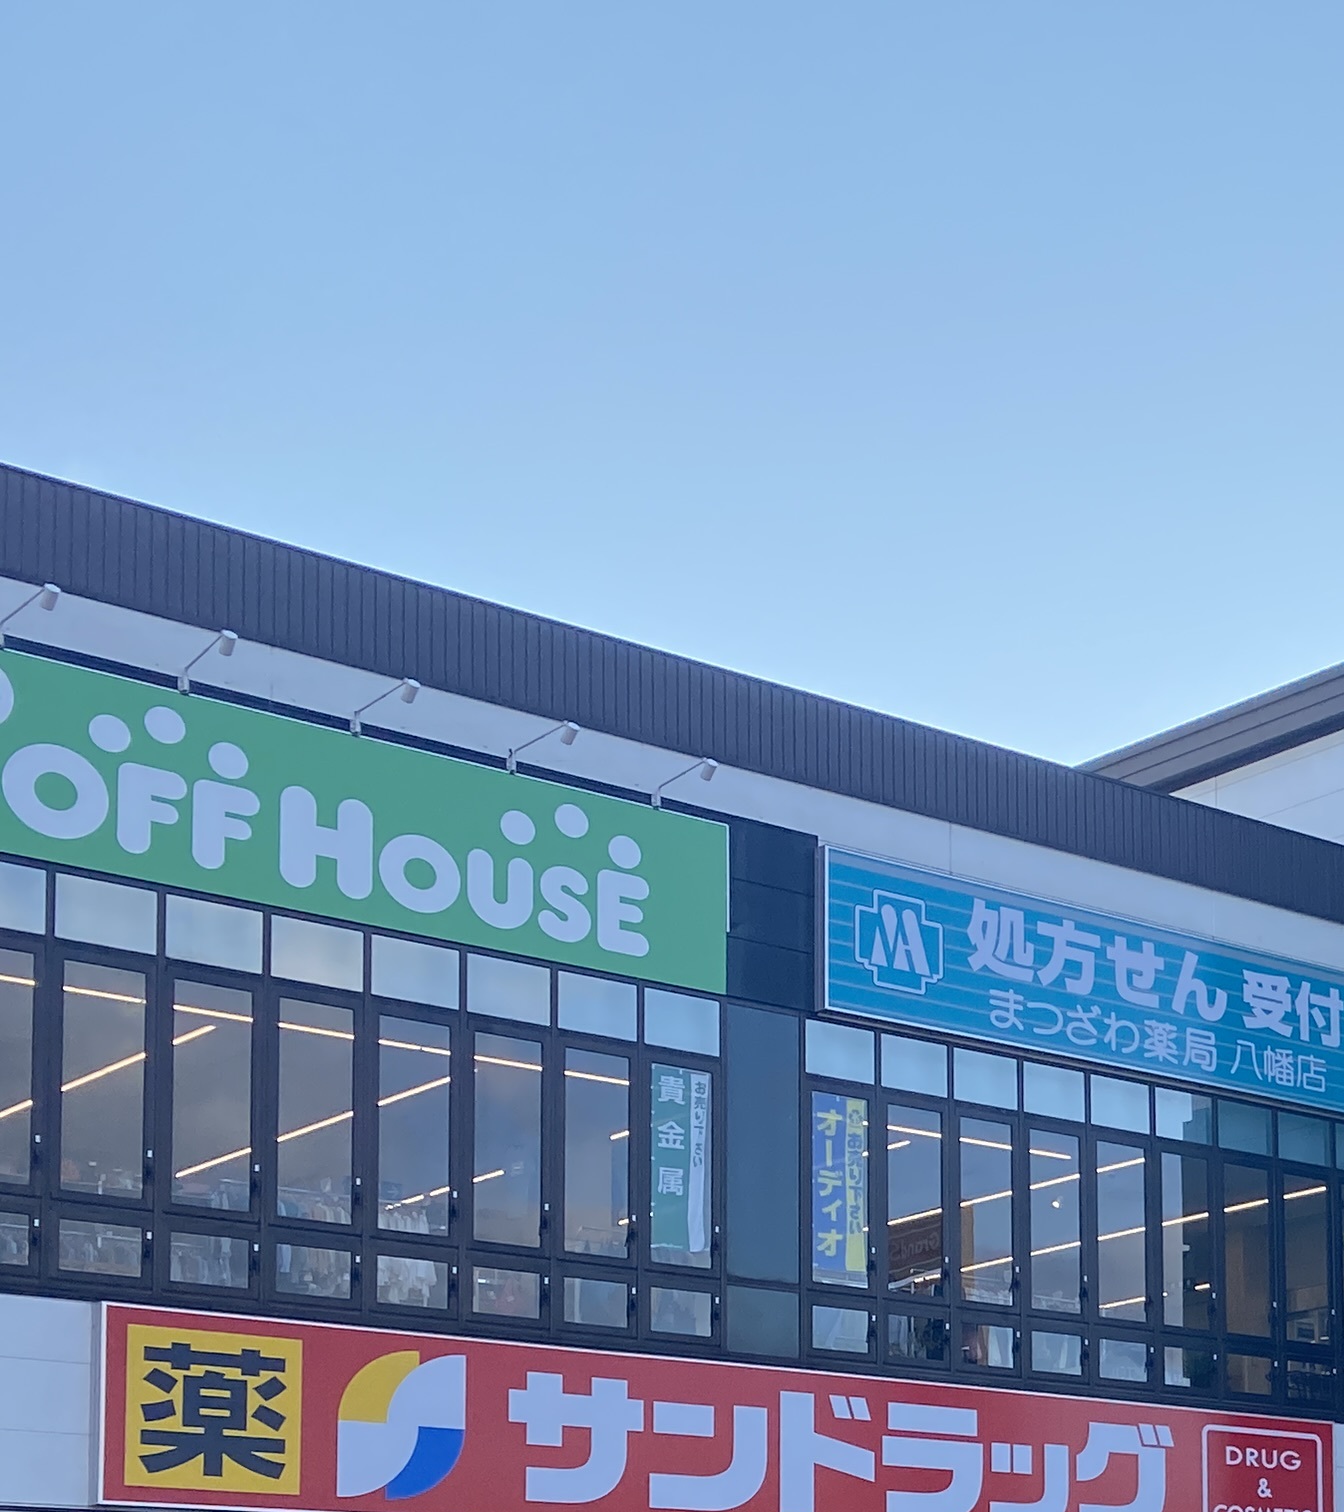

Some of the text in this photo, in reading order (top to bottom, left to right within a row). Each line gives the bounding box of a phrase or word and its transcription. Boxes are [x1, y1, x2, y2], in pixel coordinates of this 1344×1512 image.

[2, 742, 650, 957] OFF HOUSE
[968, 899, 1227, 1022] 処方せん
[1242, 969, 1343, 1046] 受付
[988, 990, 1327, 1092] まつざわ薬局 八幡店
[657, 1075, 686, 1196] 貴金属
[816, 1109, 844, 1257] オーディオ
[139, 1342, 287, 1479] 薬
[1225, 1445, 1302, 1471] DRUG
[1257, 1477, 1273, 1499] &
